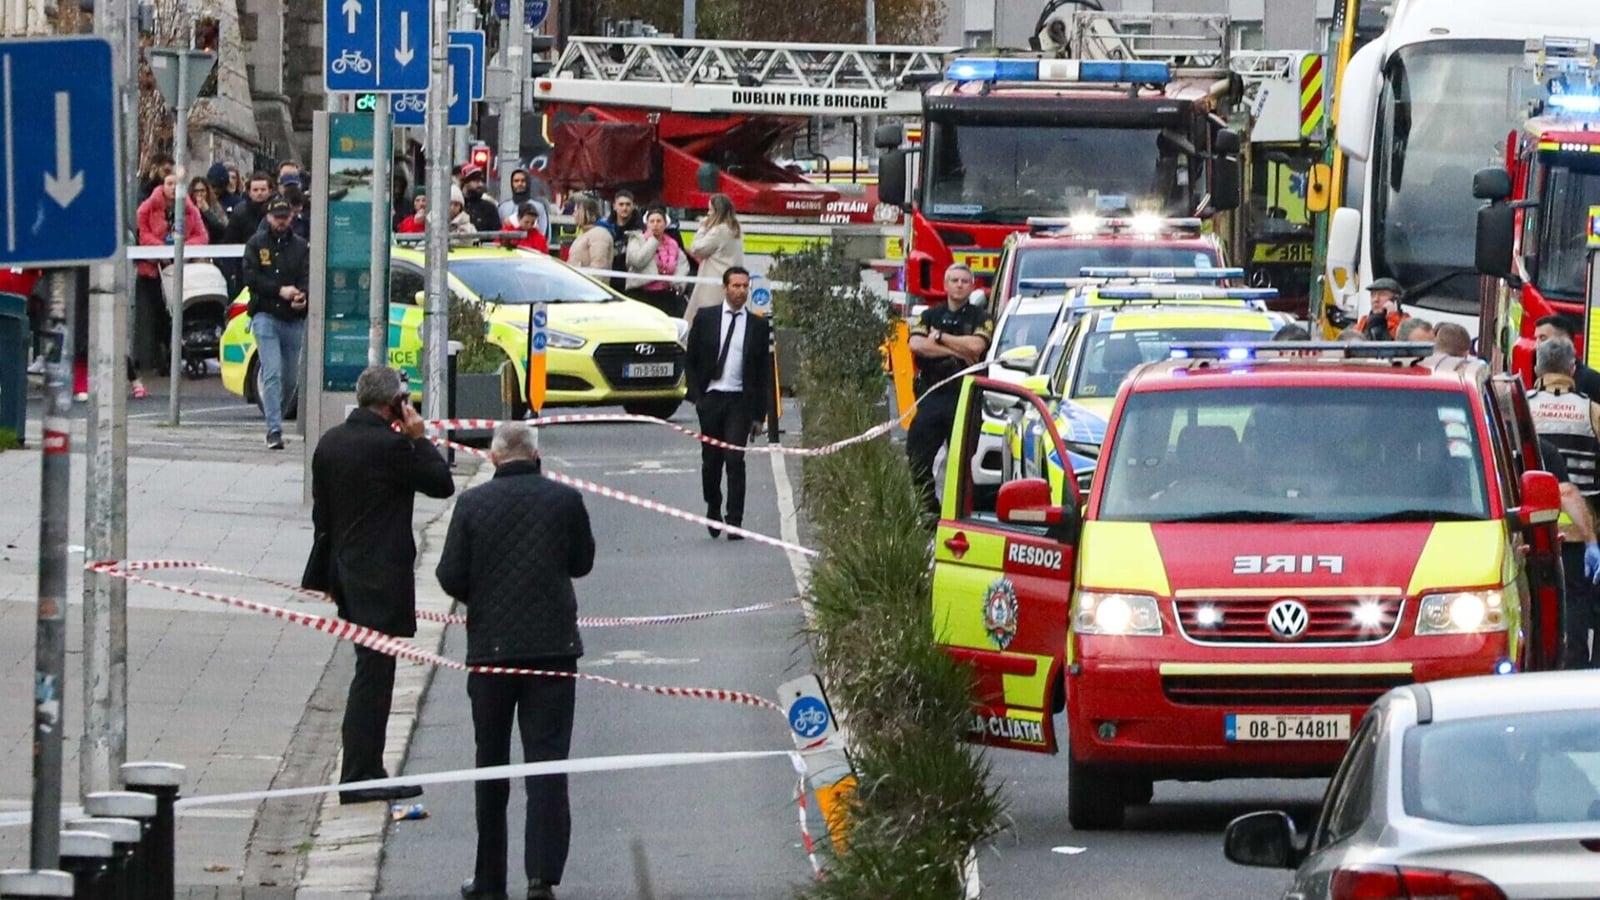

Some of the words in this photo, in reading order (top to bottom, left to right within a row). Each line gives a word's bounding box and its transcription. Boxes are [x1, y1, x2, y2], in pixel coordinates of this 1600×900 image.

[732, 91, 786, 106] DUBLIN
[790, 93, 821, 107] FIRE
[824, 94, 889, 109] BRIGADE
[1532, 411, 1585, 420] COMMANDER
[1539, 402, 1576, 411] INCIDENT
[989, 716, 1043, 741] CLIATH
[1249, 720, 1338, 738] 08-D-44811
